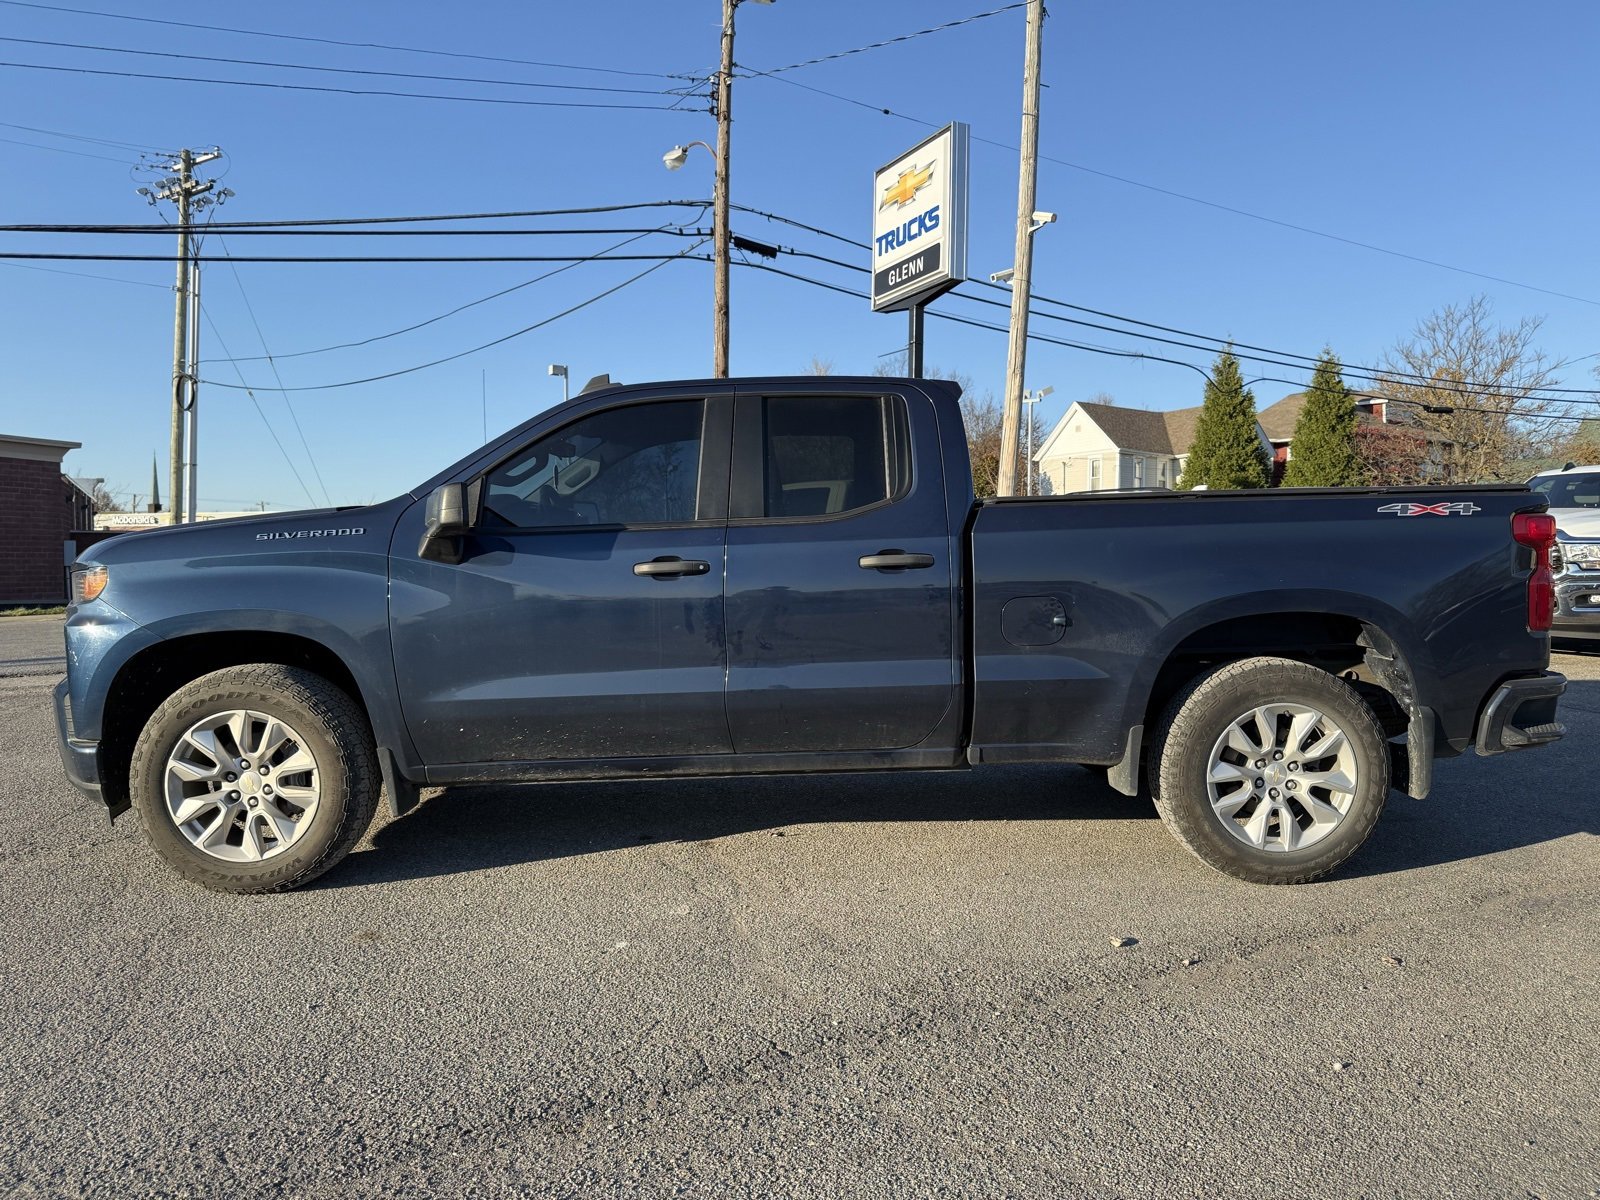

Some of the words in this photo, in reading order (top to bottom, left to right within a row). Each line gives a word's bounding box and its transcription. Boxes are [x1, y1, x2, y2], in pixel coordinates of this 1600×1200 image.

[876, 205, 939, 256] TRUCKS
[888, 256, 924, 286] GLENN
[255, 527, 365, 540] SILVERADO
